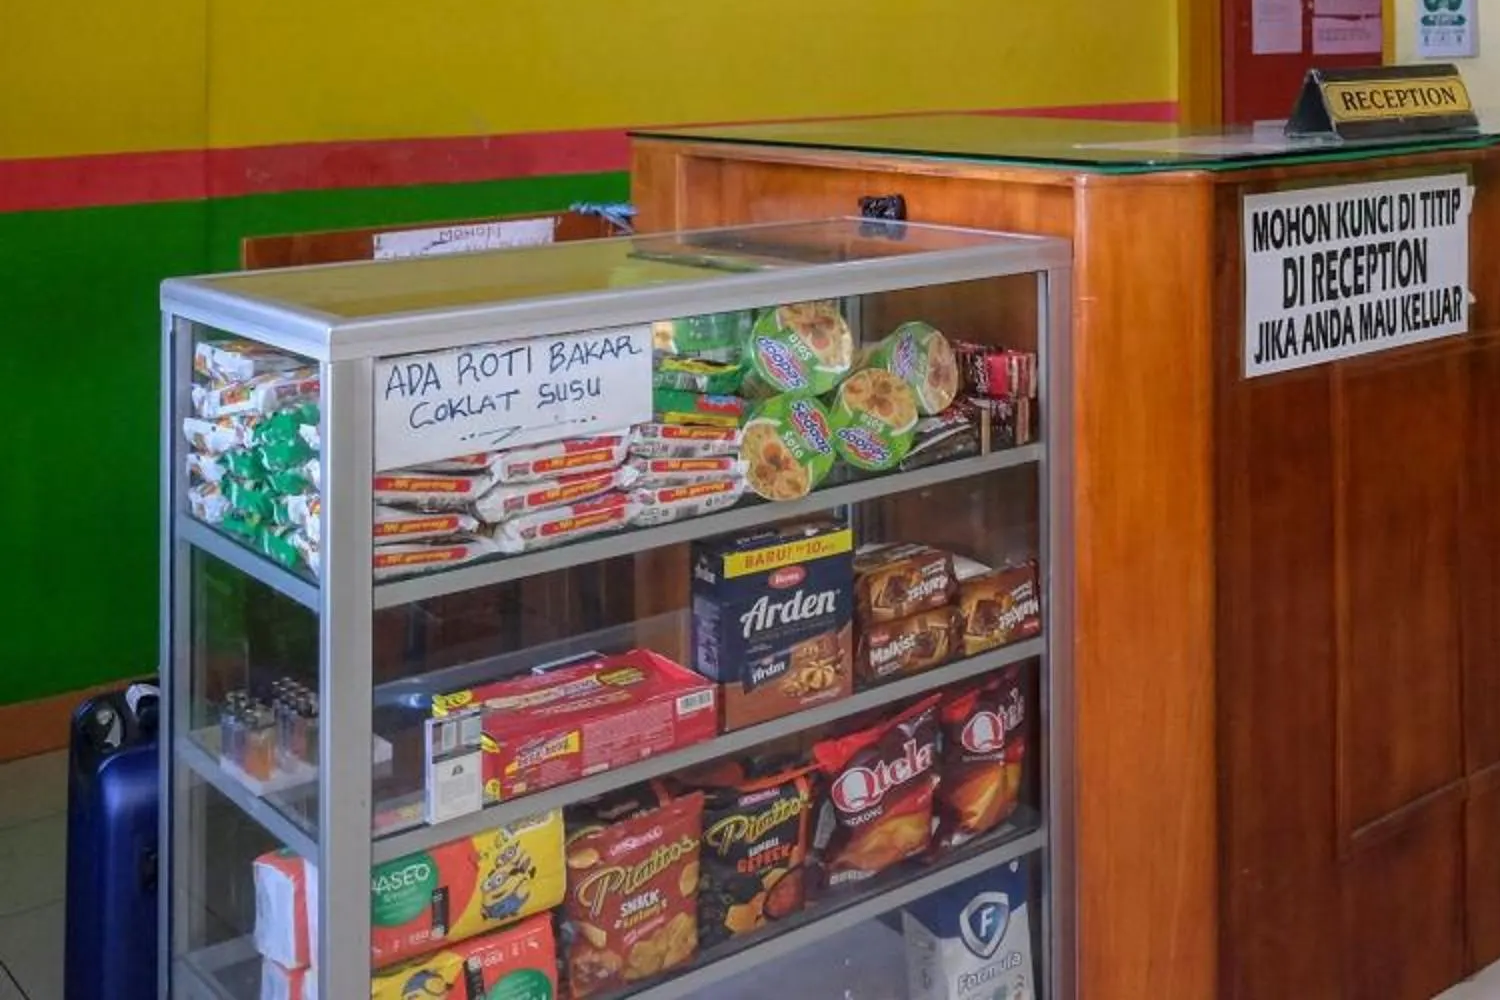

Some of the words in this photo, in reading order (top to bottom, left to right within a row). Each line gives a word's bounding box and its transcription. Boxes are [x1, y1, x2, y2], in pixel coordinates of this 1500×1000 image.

[1340, 86, 1458, 112] RECEPTION
[1252, 202, 1332, 253] MOHON
[1336, 195, 1395, 240] KUNCI
[1399, 193, 1416, 232] DI
[1419, 187, 1462, 229] TITIP
[1282, 254, 1305, 310] DI
[1311, 236, 1428, 305] RECEPTION
[1254, 316, 1299, 365] JIKA
[1301, 306, 1355, 355] ANDA
[1358, 297, 1398, 343] MAU
[1401, 285, 1463, 333] KELUAR
[385, 360, 442, 400] ADA
[457, 345, 532, 386] ROTI
[549, 334, 643, 374] BAKAR
[409, 388, 520, 429] COKLAT
[536, 376, 602, 409] SUSU
[739, 588, 837, 640] Arden
[831, 738, 935, 813] Qtela
